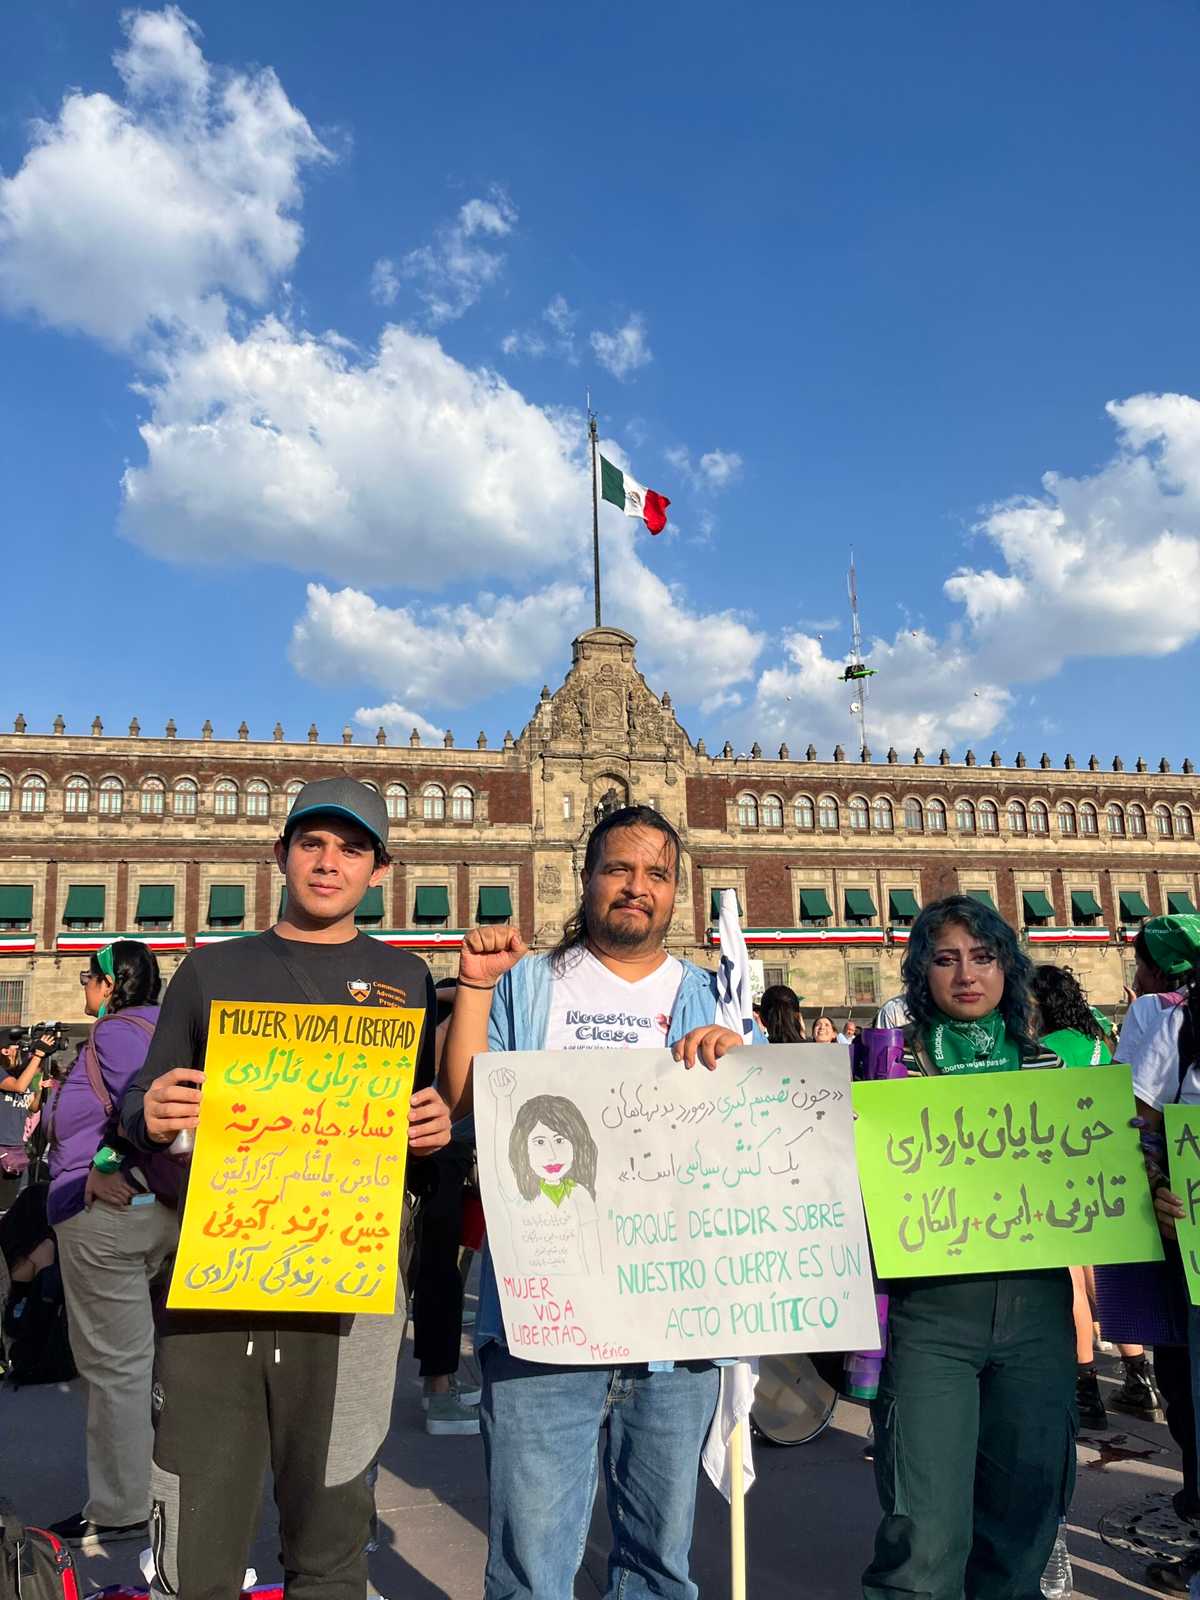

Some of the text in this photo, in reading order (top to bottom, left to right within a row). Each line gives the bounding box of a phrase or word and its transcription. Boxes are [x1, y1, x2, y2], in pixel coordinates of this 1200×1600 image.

[344, 1015, 416, 1049] LIBERTAD
[566, 1009, 652, 1028] Nuestra
[575, 1025, 639, 1043] Clase
[943, 1062, 965, 1073] borto
[886, 1096, 1114, 1175] حق پایان بارداری
[677, 1138, 720, 1190] سیاسی
[721, 1127, 782, 1188] کنش
[767, 1126, 814, 1186] یک
[688, 1205, 779, 1239] DECIDIR
[783, 1201, 846, 1232] SOBRE
[616, 1241, 862, 1295] NUESTRO CUERPX ES UN
[503, 1275, 555, 1300] MUJER
[532, 1299, 575, 1323] VIDA
[665, 1304, 721, 1341] ACTO
[511, 1322, 632, 1361] LIBERTAD México
